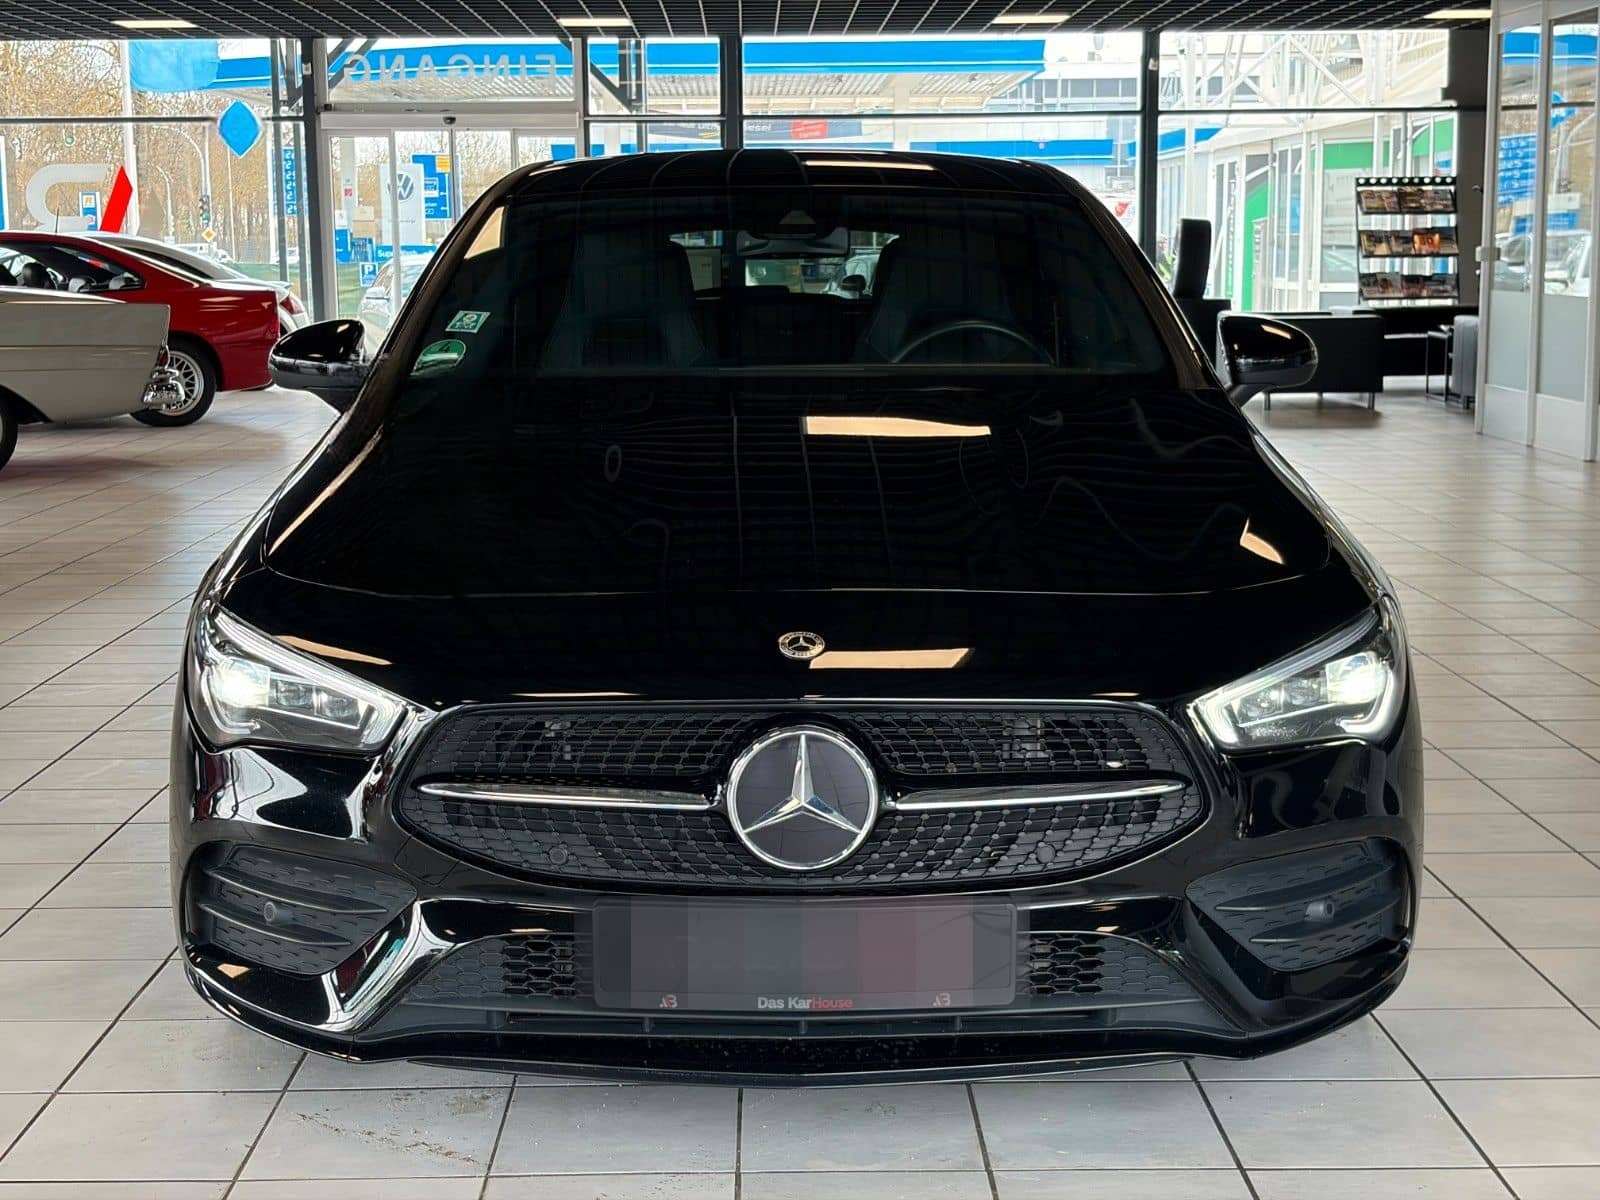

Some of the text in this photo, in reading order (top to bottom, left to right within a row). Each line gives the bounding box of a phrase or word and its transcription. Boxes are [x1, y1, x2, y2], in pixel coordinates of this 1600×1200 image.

[365, 264, 374, 275] P
[757, 996, 854, 1009] Das KarHouse
